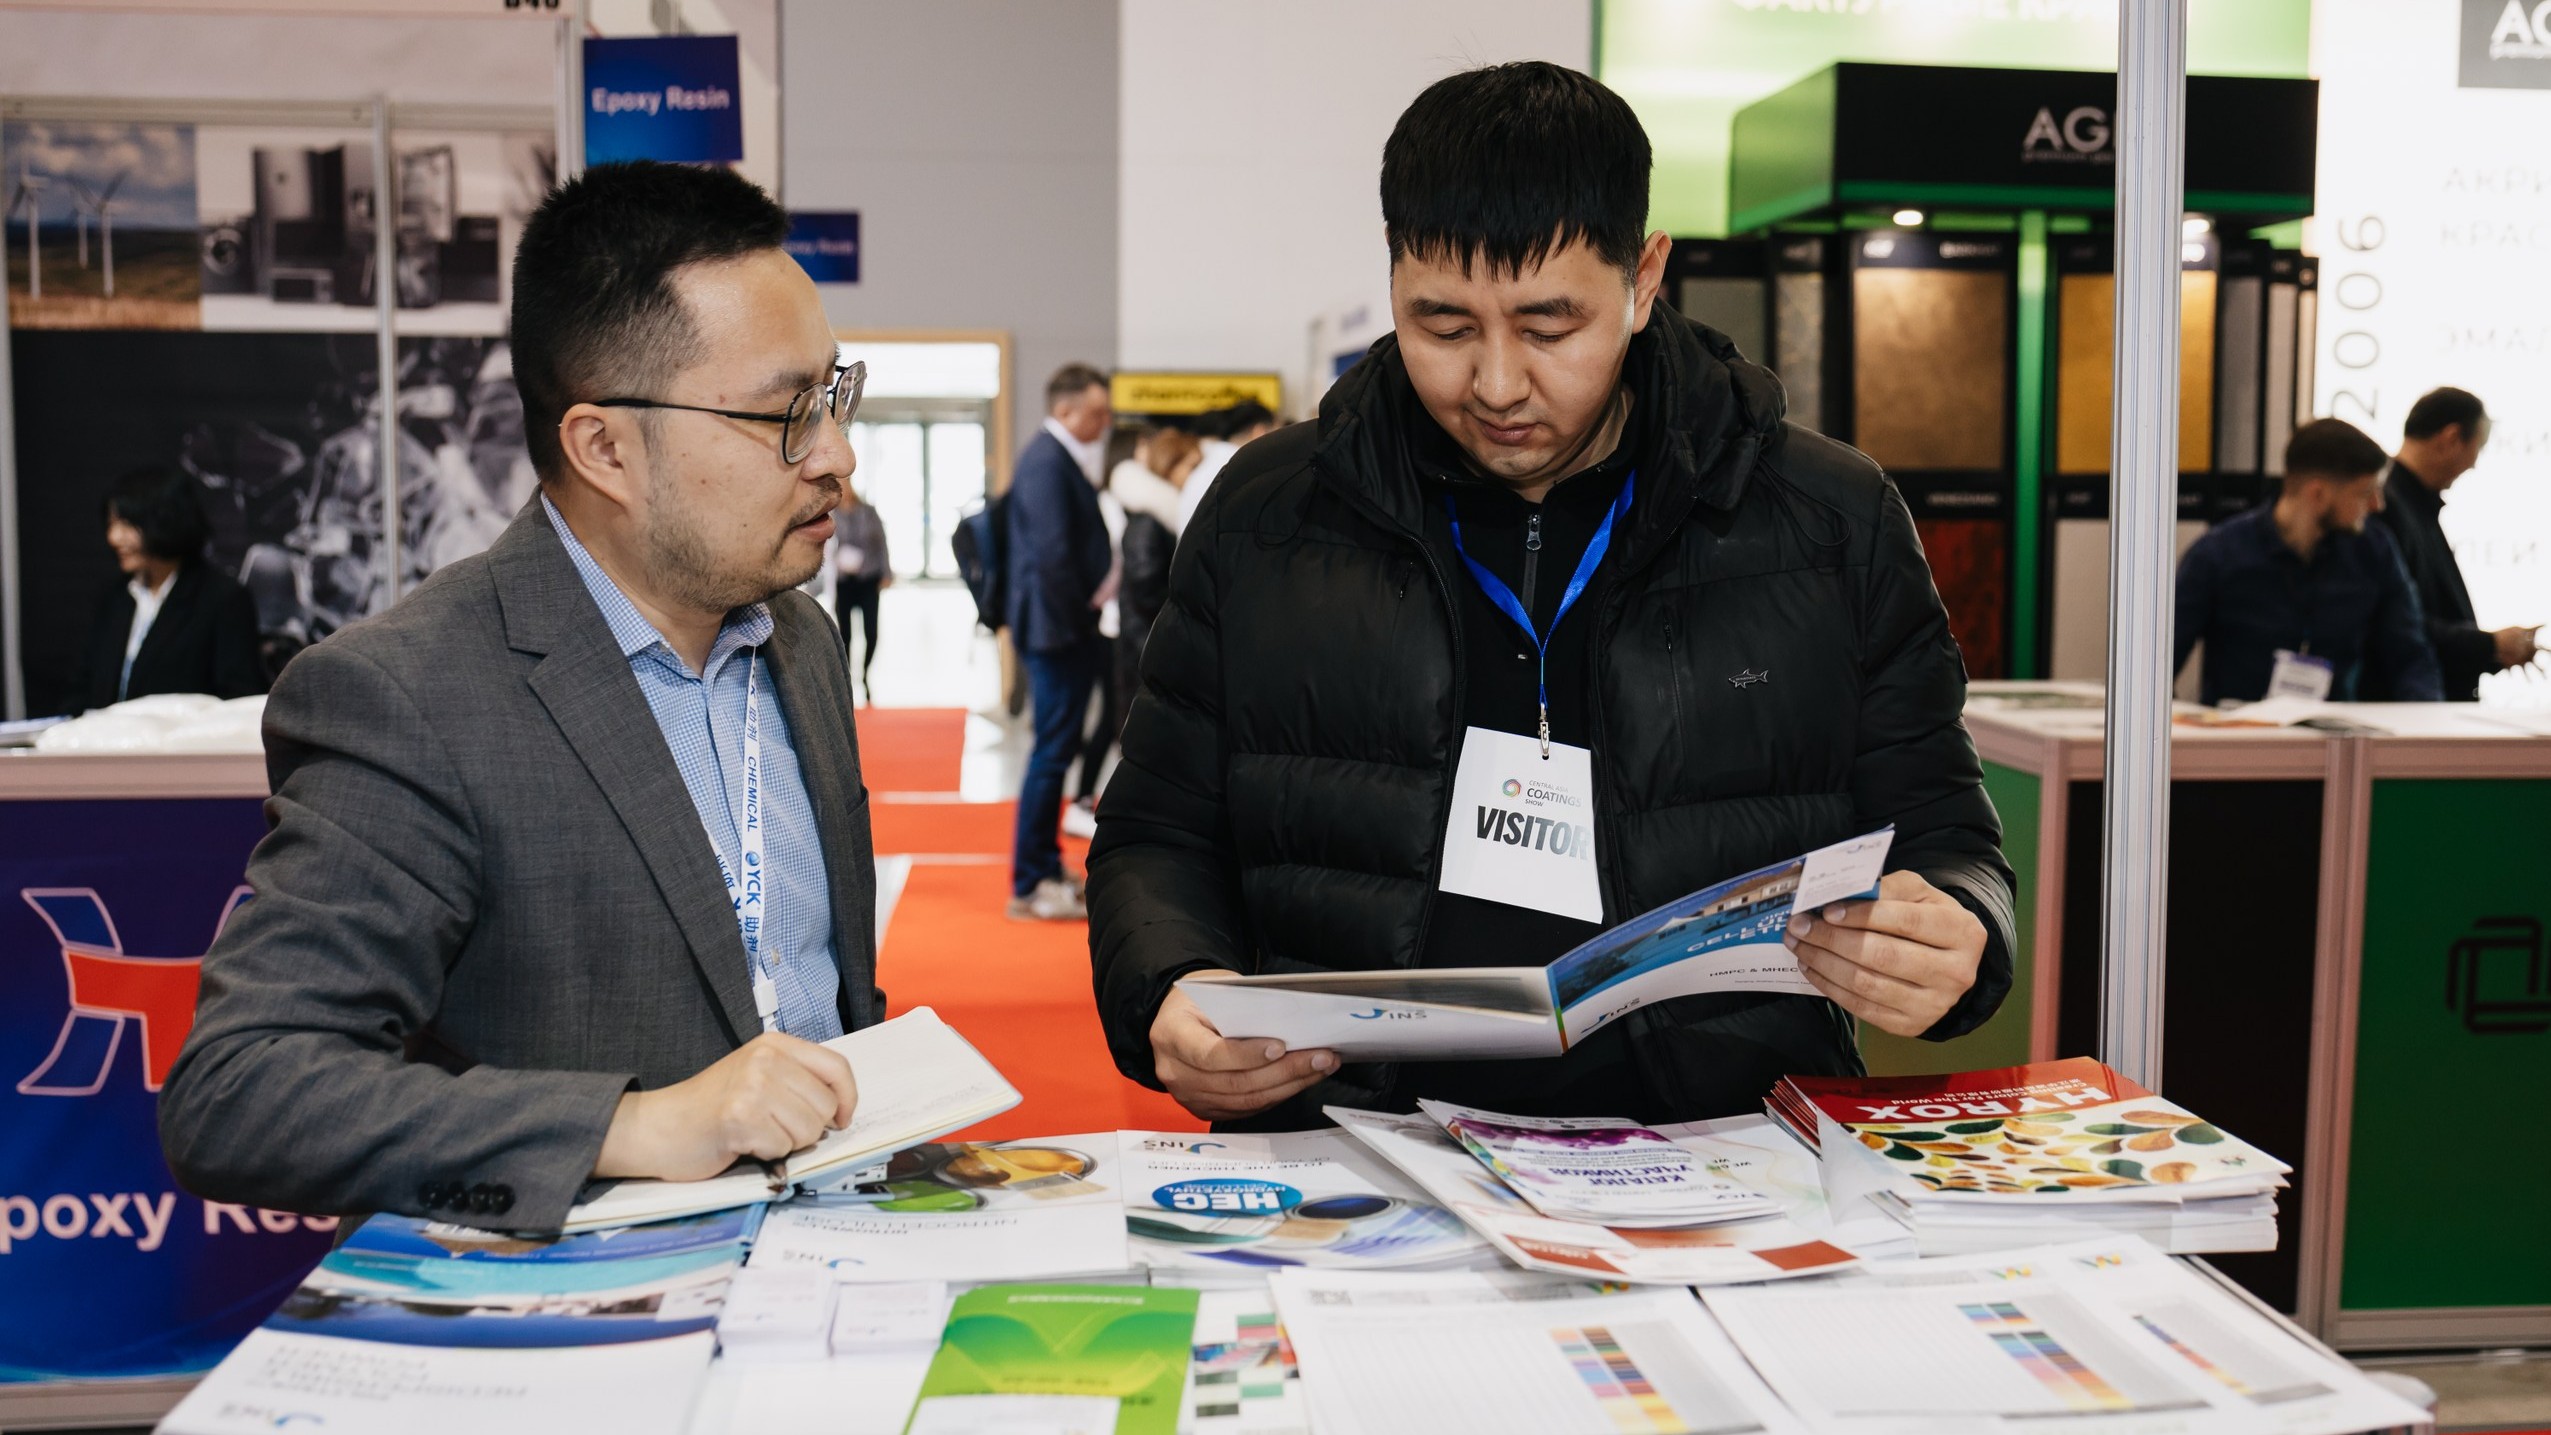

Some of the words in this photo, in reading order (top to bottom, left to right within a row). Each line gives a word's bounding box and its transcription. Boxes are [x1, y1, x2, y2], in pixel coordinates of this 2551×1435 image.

[591, 87, 662, 117] Epoxy
[665, 84, 730, 111] Resin
[2022, 105, 2116, 154] AG
[746, 755, 759, 833] CHEMICAL
[1526, 787, 1582, 808] COATINGS
[1529, 779, 1556, 792] CENTRAL
[1525, 798, 1544, 807] SHOW
[1476, 804, 1593, 862] VISITOR
[746, 869, 762, 905] YCK
[1856, 1086, 2112, 1120] HYROX
[1890, 1097, 1933, 1105] World
[1172, 1192, 1281, 1210] HEC
